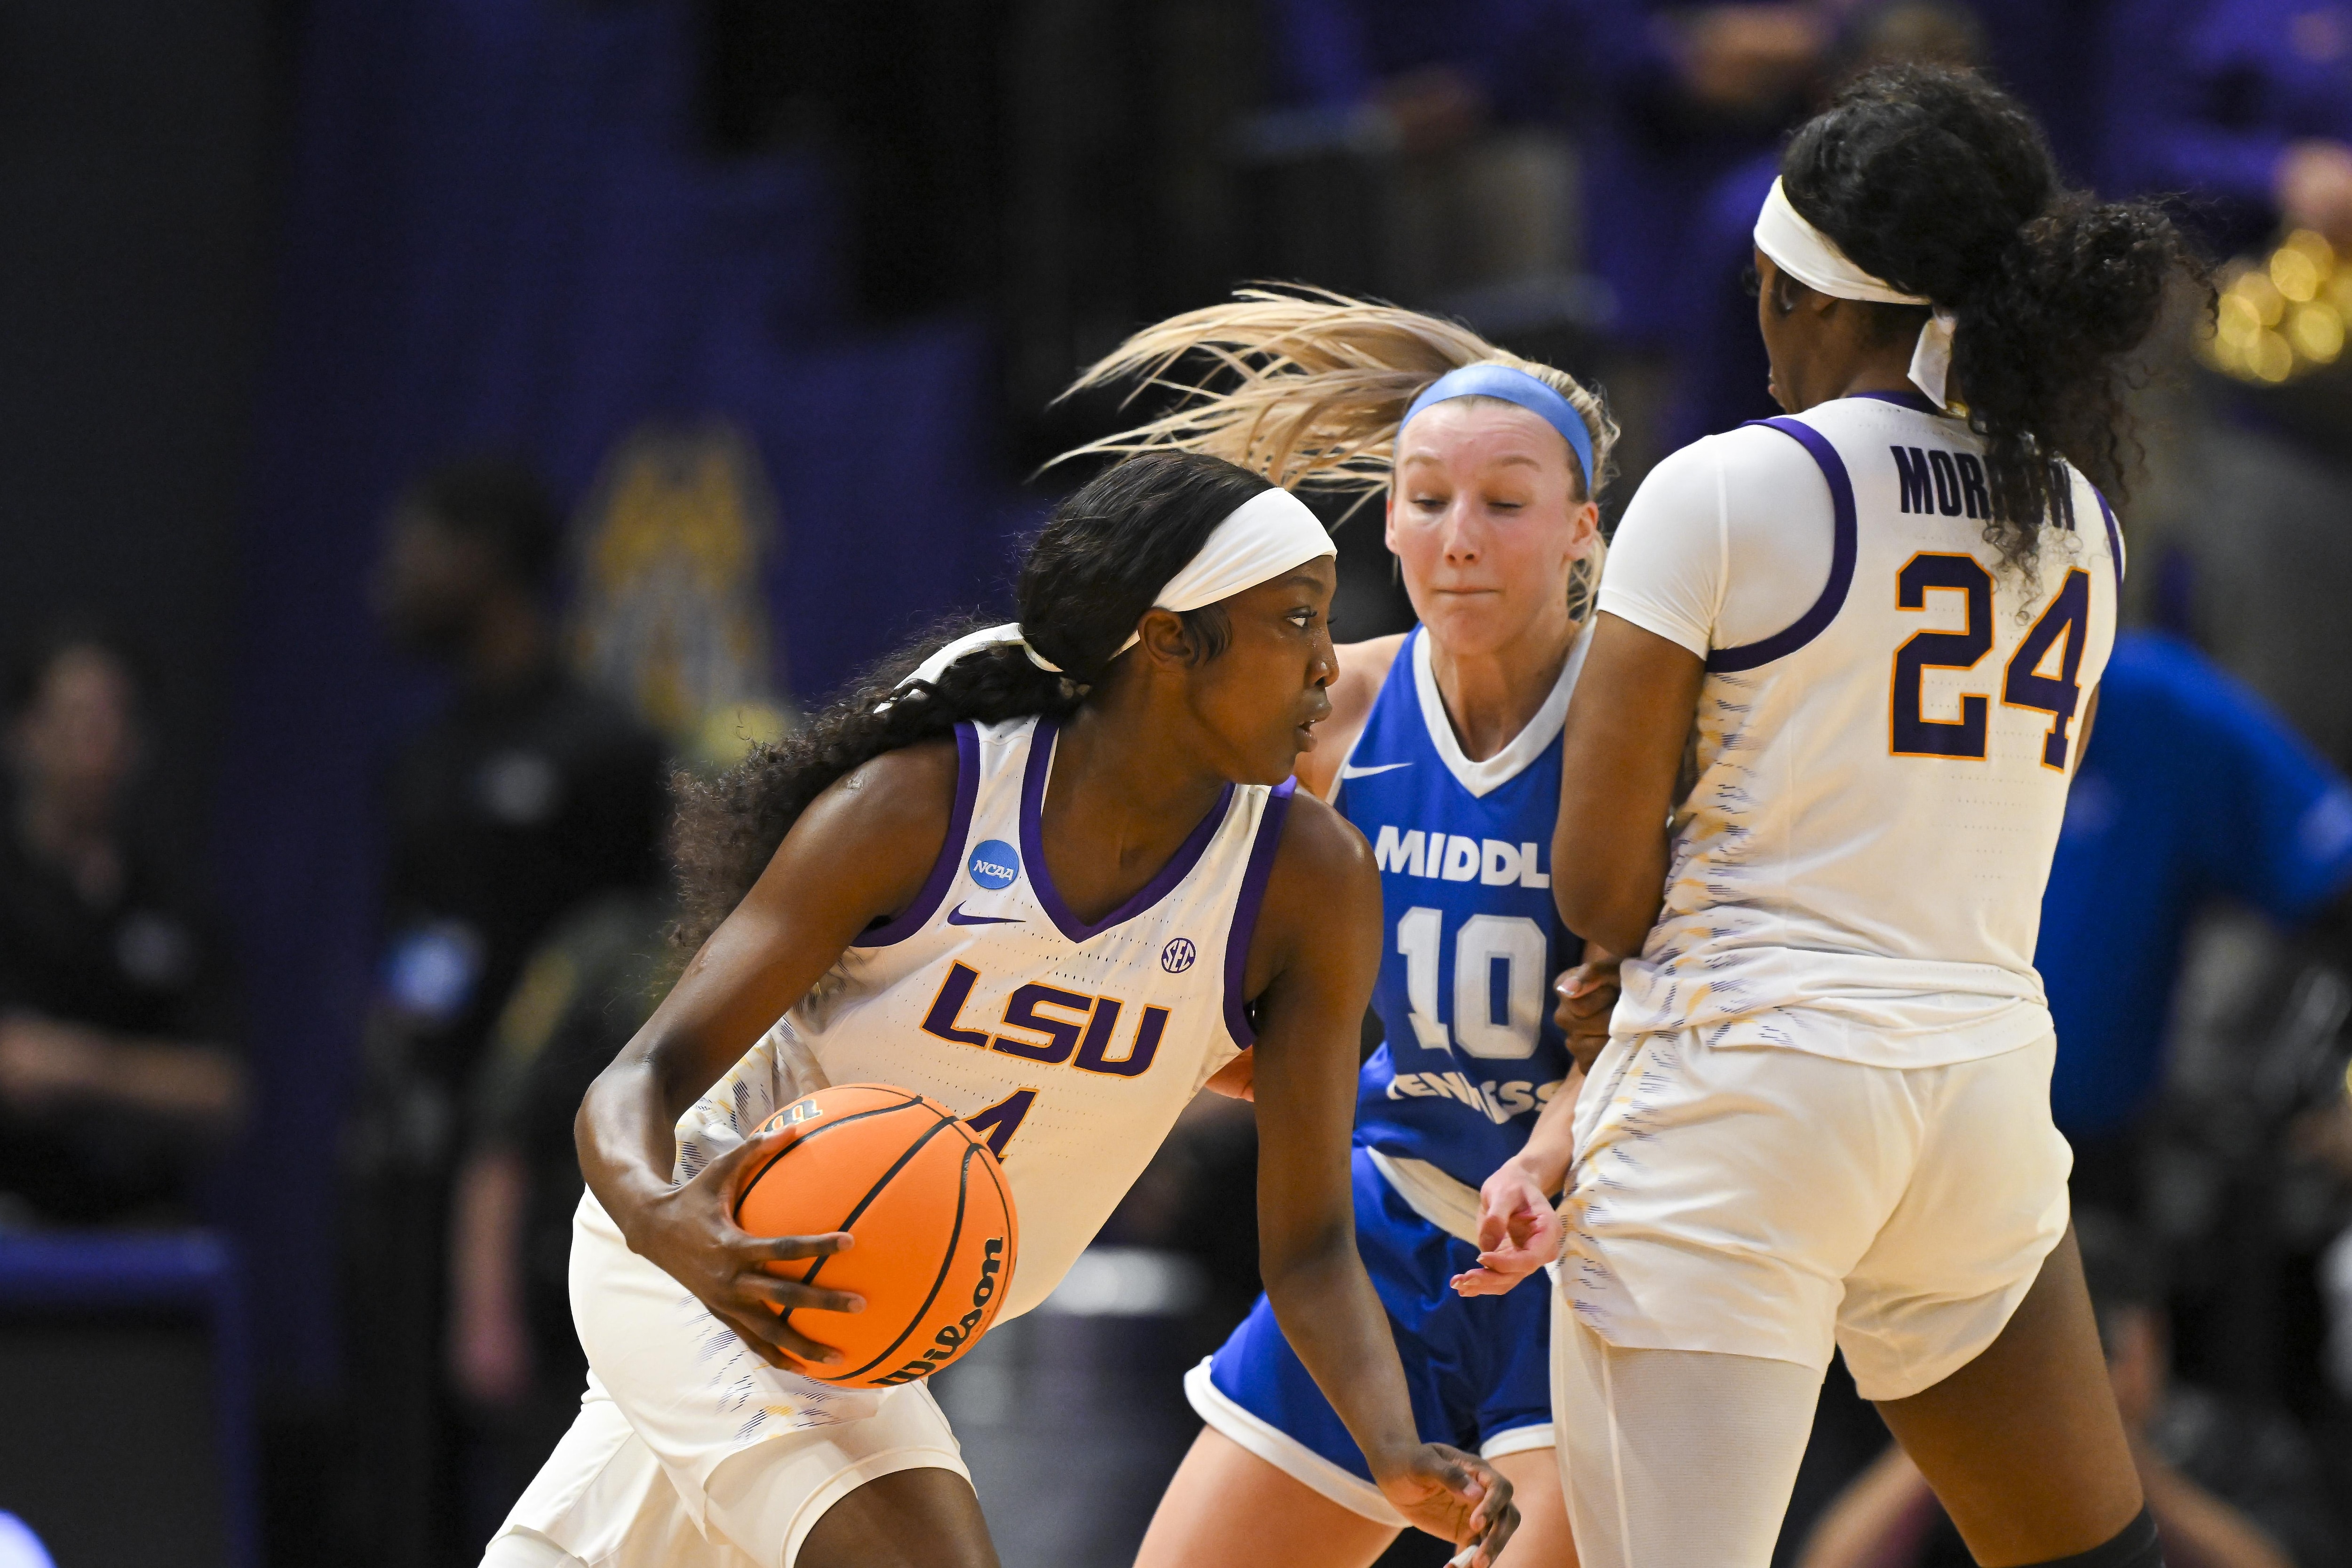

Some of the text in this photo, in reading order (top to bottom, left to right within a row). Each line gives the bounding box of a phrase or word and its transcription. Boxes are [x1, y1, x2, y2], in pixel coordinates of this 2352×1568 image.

[1890, 446, 2075, 531] MORW
[1889, 551, 2090, 774] 24
[973, 860, 1014, 880] NCAA
[1162, 939, 1194, 972] SEC
[1397, 906, 1547, 1059] 10
[920, 959, 1172, 1078] LSU
[867, 1236, 1003, 1386] Wilson
